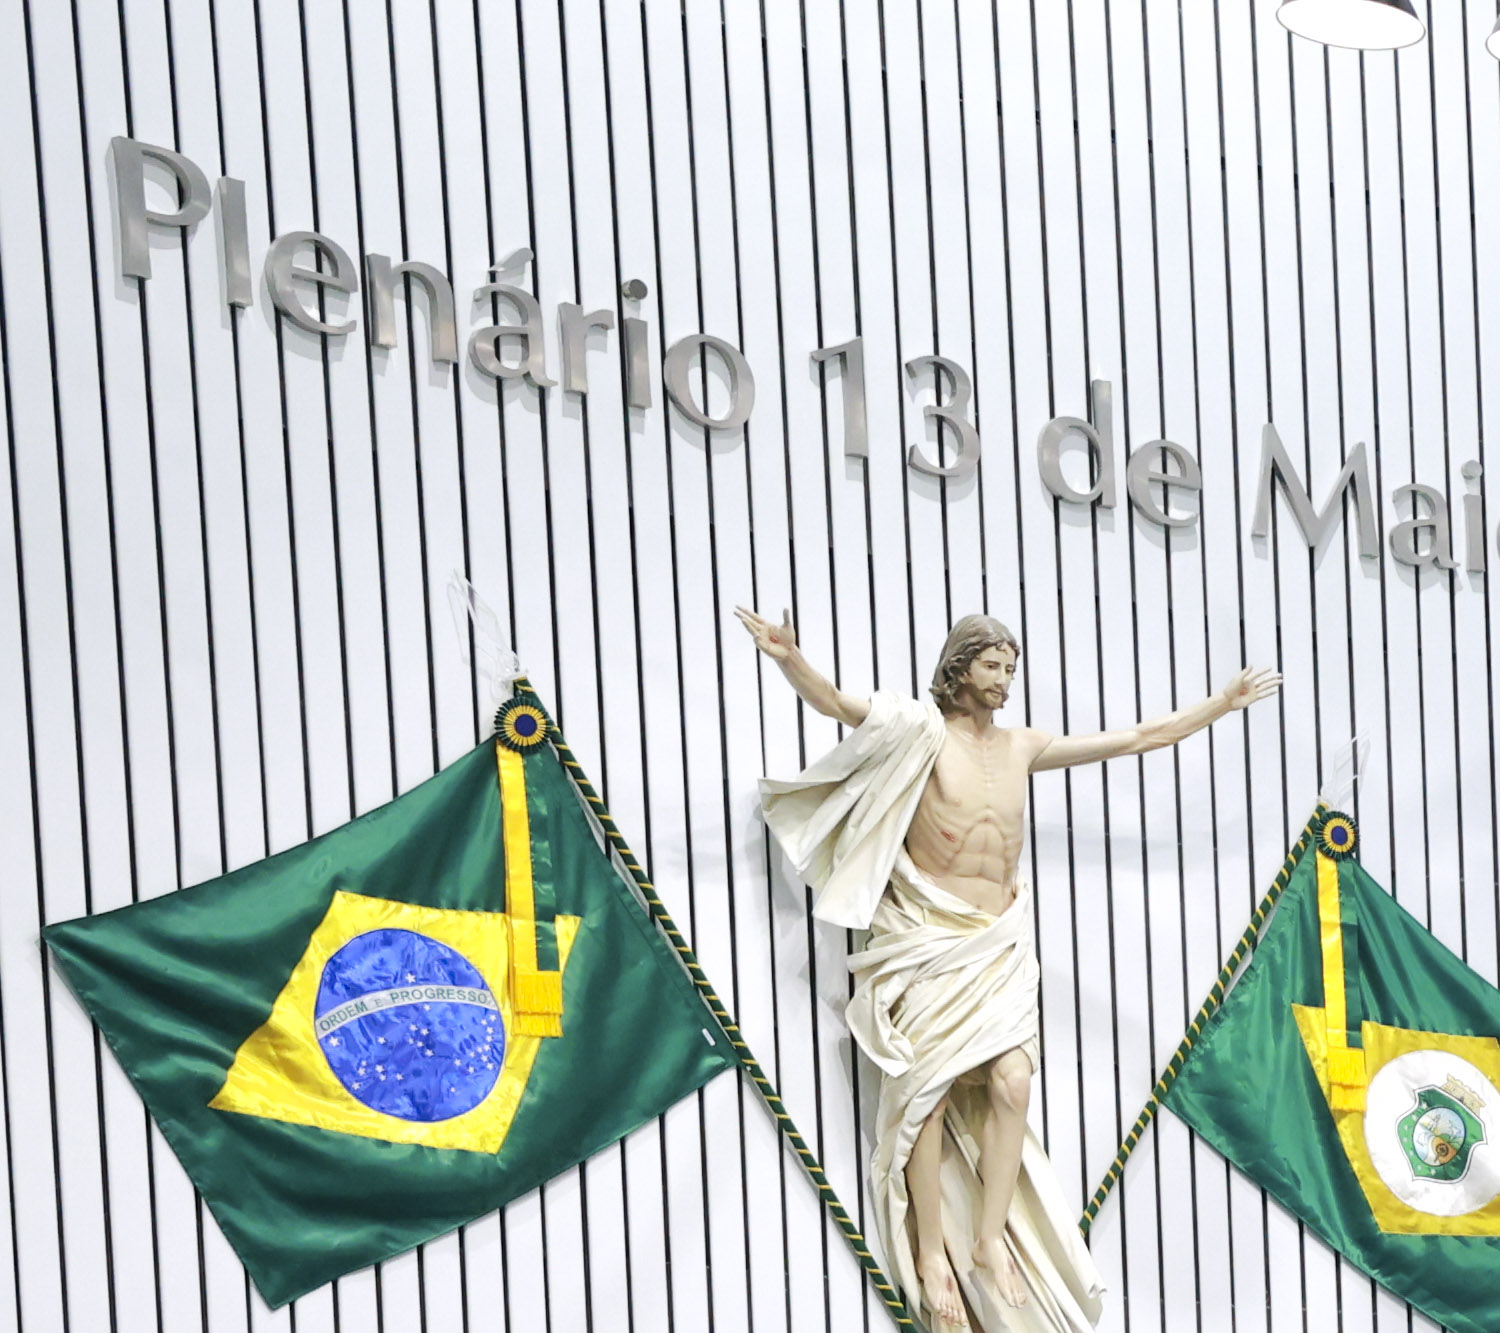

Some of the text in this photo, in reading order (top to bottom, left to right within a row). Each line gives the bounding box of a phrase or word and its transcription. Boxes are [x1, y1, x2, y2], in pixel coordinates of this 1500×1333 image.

[110, 135, 755, 431] Plenário
[809, 336, 981, 478] 13
[1037, 379, 1201, 529] de
[319, 988, 488, 1032] ORDEM E PROGRESSO
